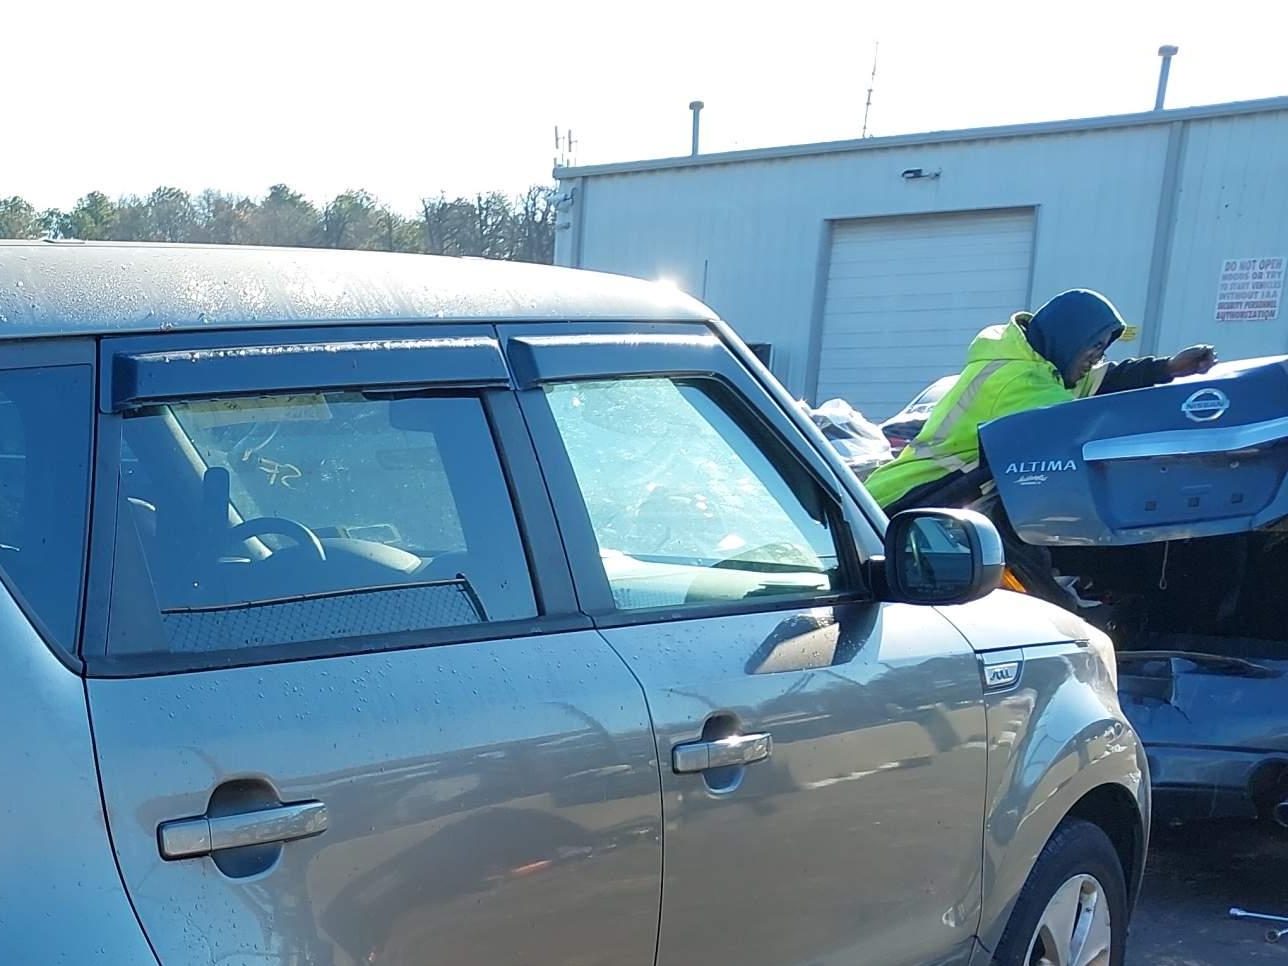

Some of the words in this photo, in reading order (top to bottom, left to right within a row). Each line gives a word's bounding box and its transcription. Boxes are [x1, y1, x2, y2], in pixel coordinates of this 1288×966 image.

[1239, 260, 1257, 271] NOT
[1258, 259, 1282, 271] OPEN
[1005, 460, 1077, 474] ALTIMA
